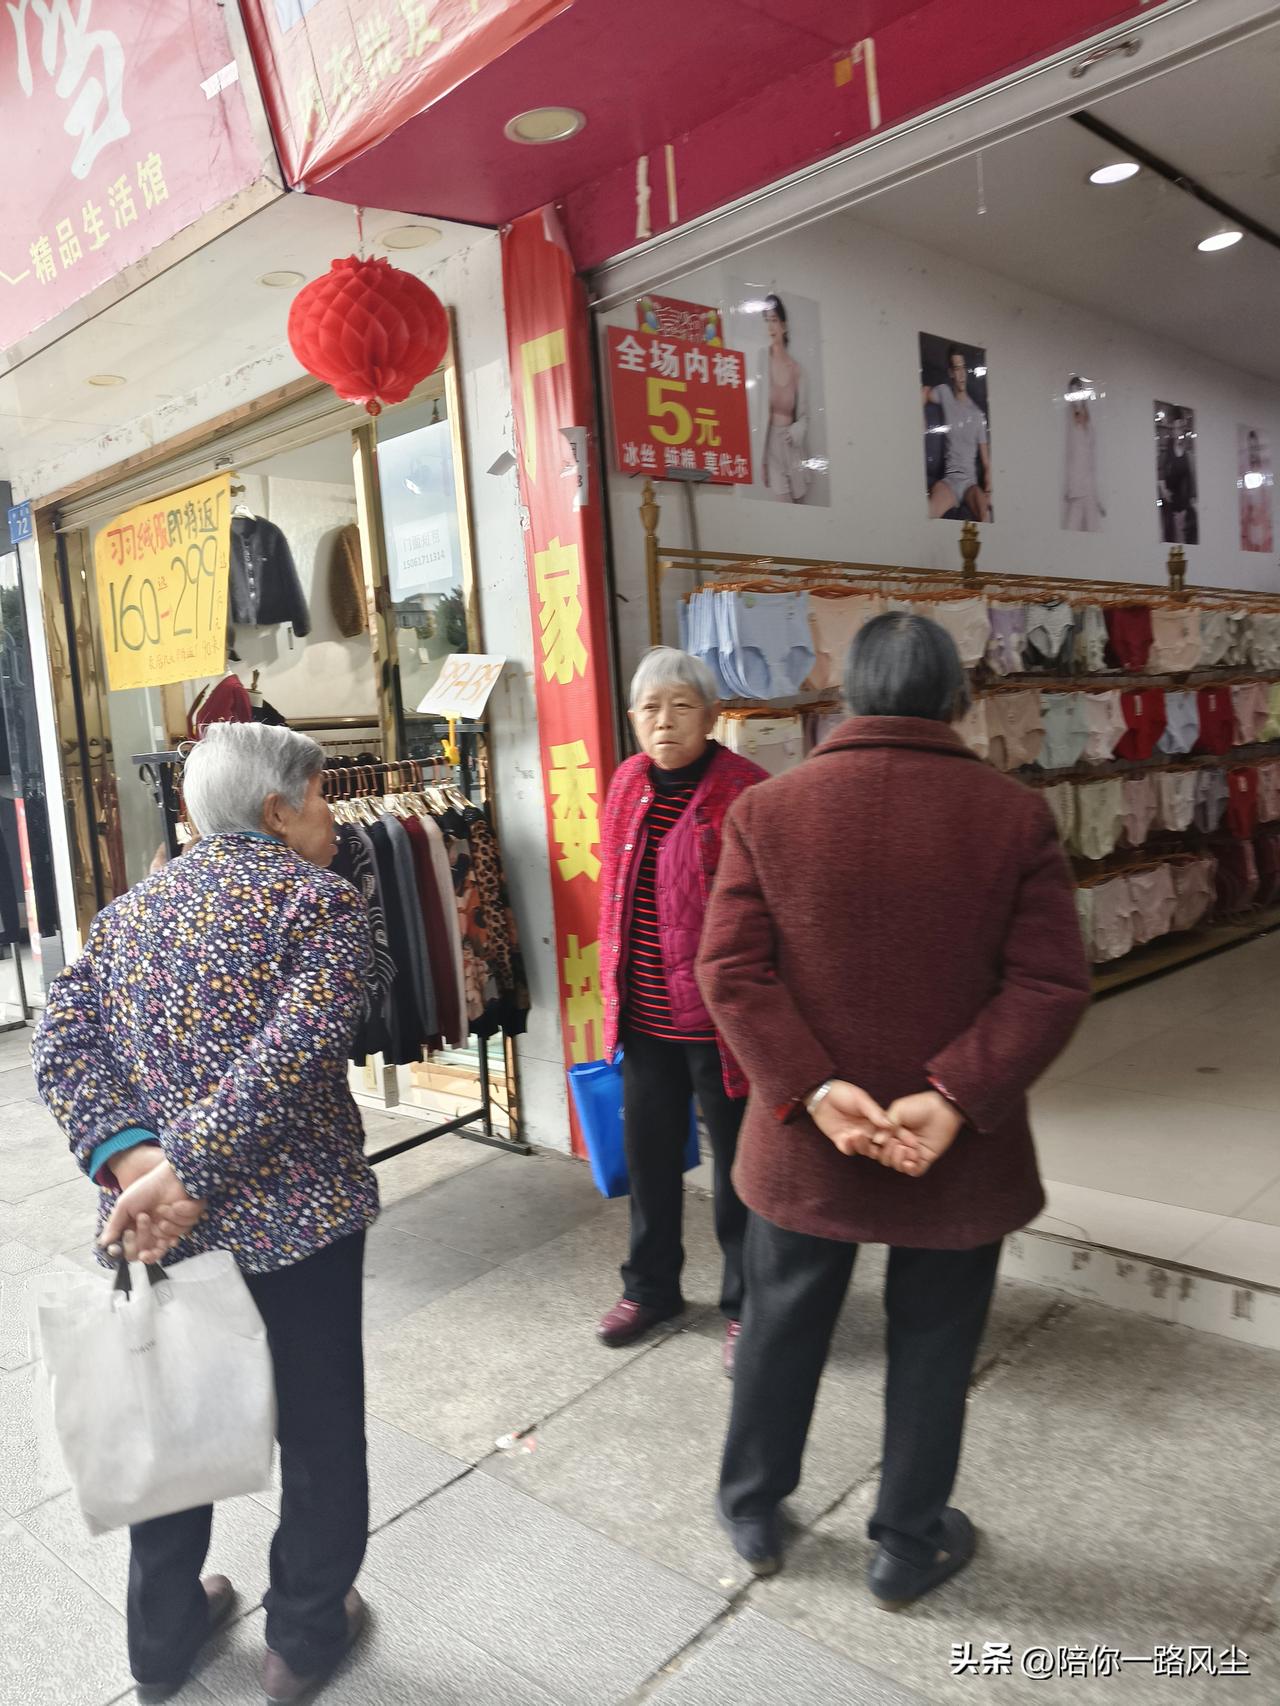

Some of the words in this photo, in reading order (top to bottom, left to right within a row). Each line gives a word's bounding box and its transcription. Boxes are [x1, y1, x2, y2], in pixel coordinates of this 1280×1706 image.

[29, 152, 169, 285] 精品生活馆
[616, 335, 741, 389] 全场内裤
[16, 518, 29, 536] 72
